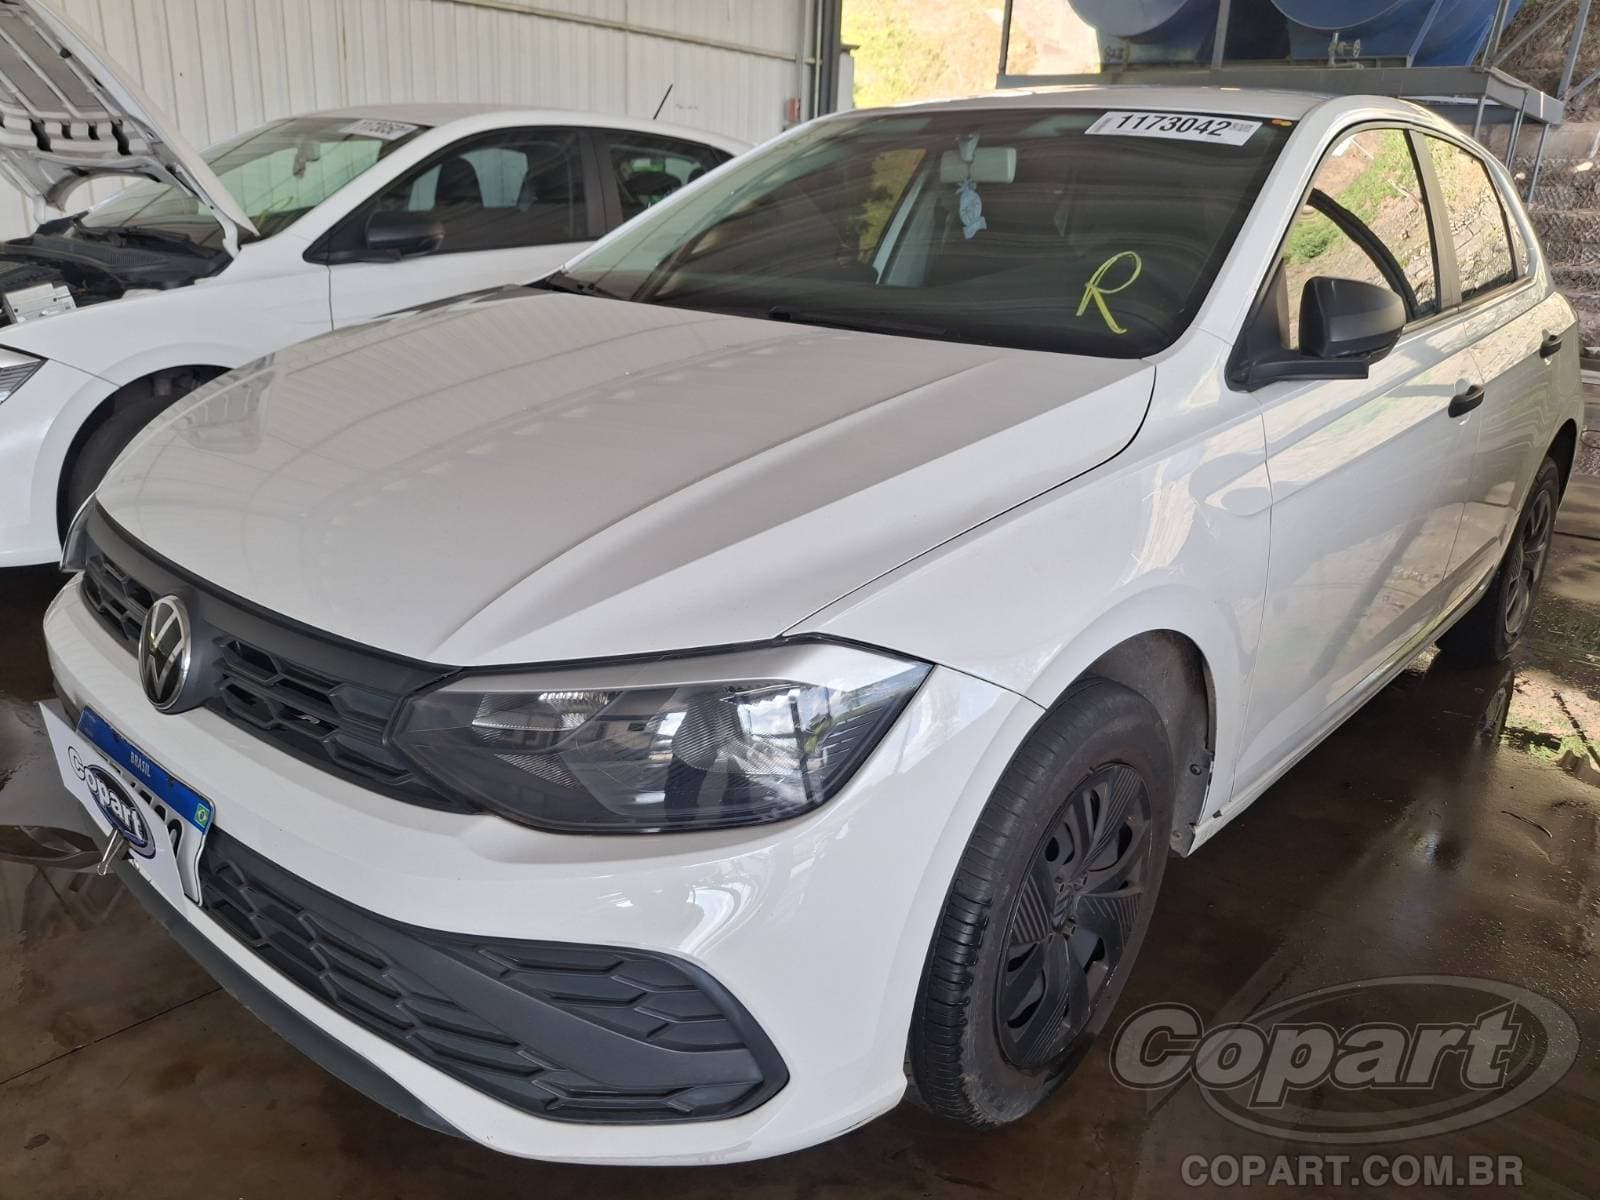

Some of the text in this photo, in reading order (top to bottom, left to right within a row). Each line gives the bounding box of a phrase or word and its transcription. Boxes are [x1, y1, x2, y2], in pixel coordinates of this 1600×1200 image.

[1116, 114, 1232, 137] 1173042
[1076, 251, 1142, 334] R
[129, 751, 152, 778] BRASIL
[68, 746, 145, 842] Copart
